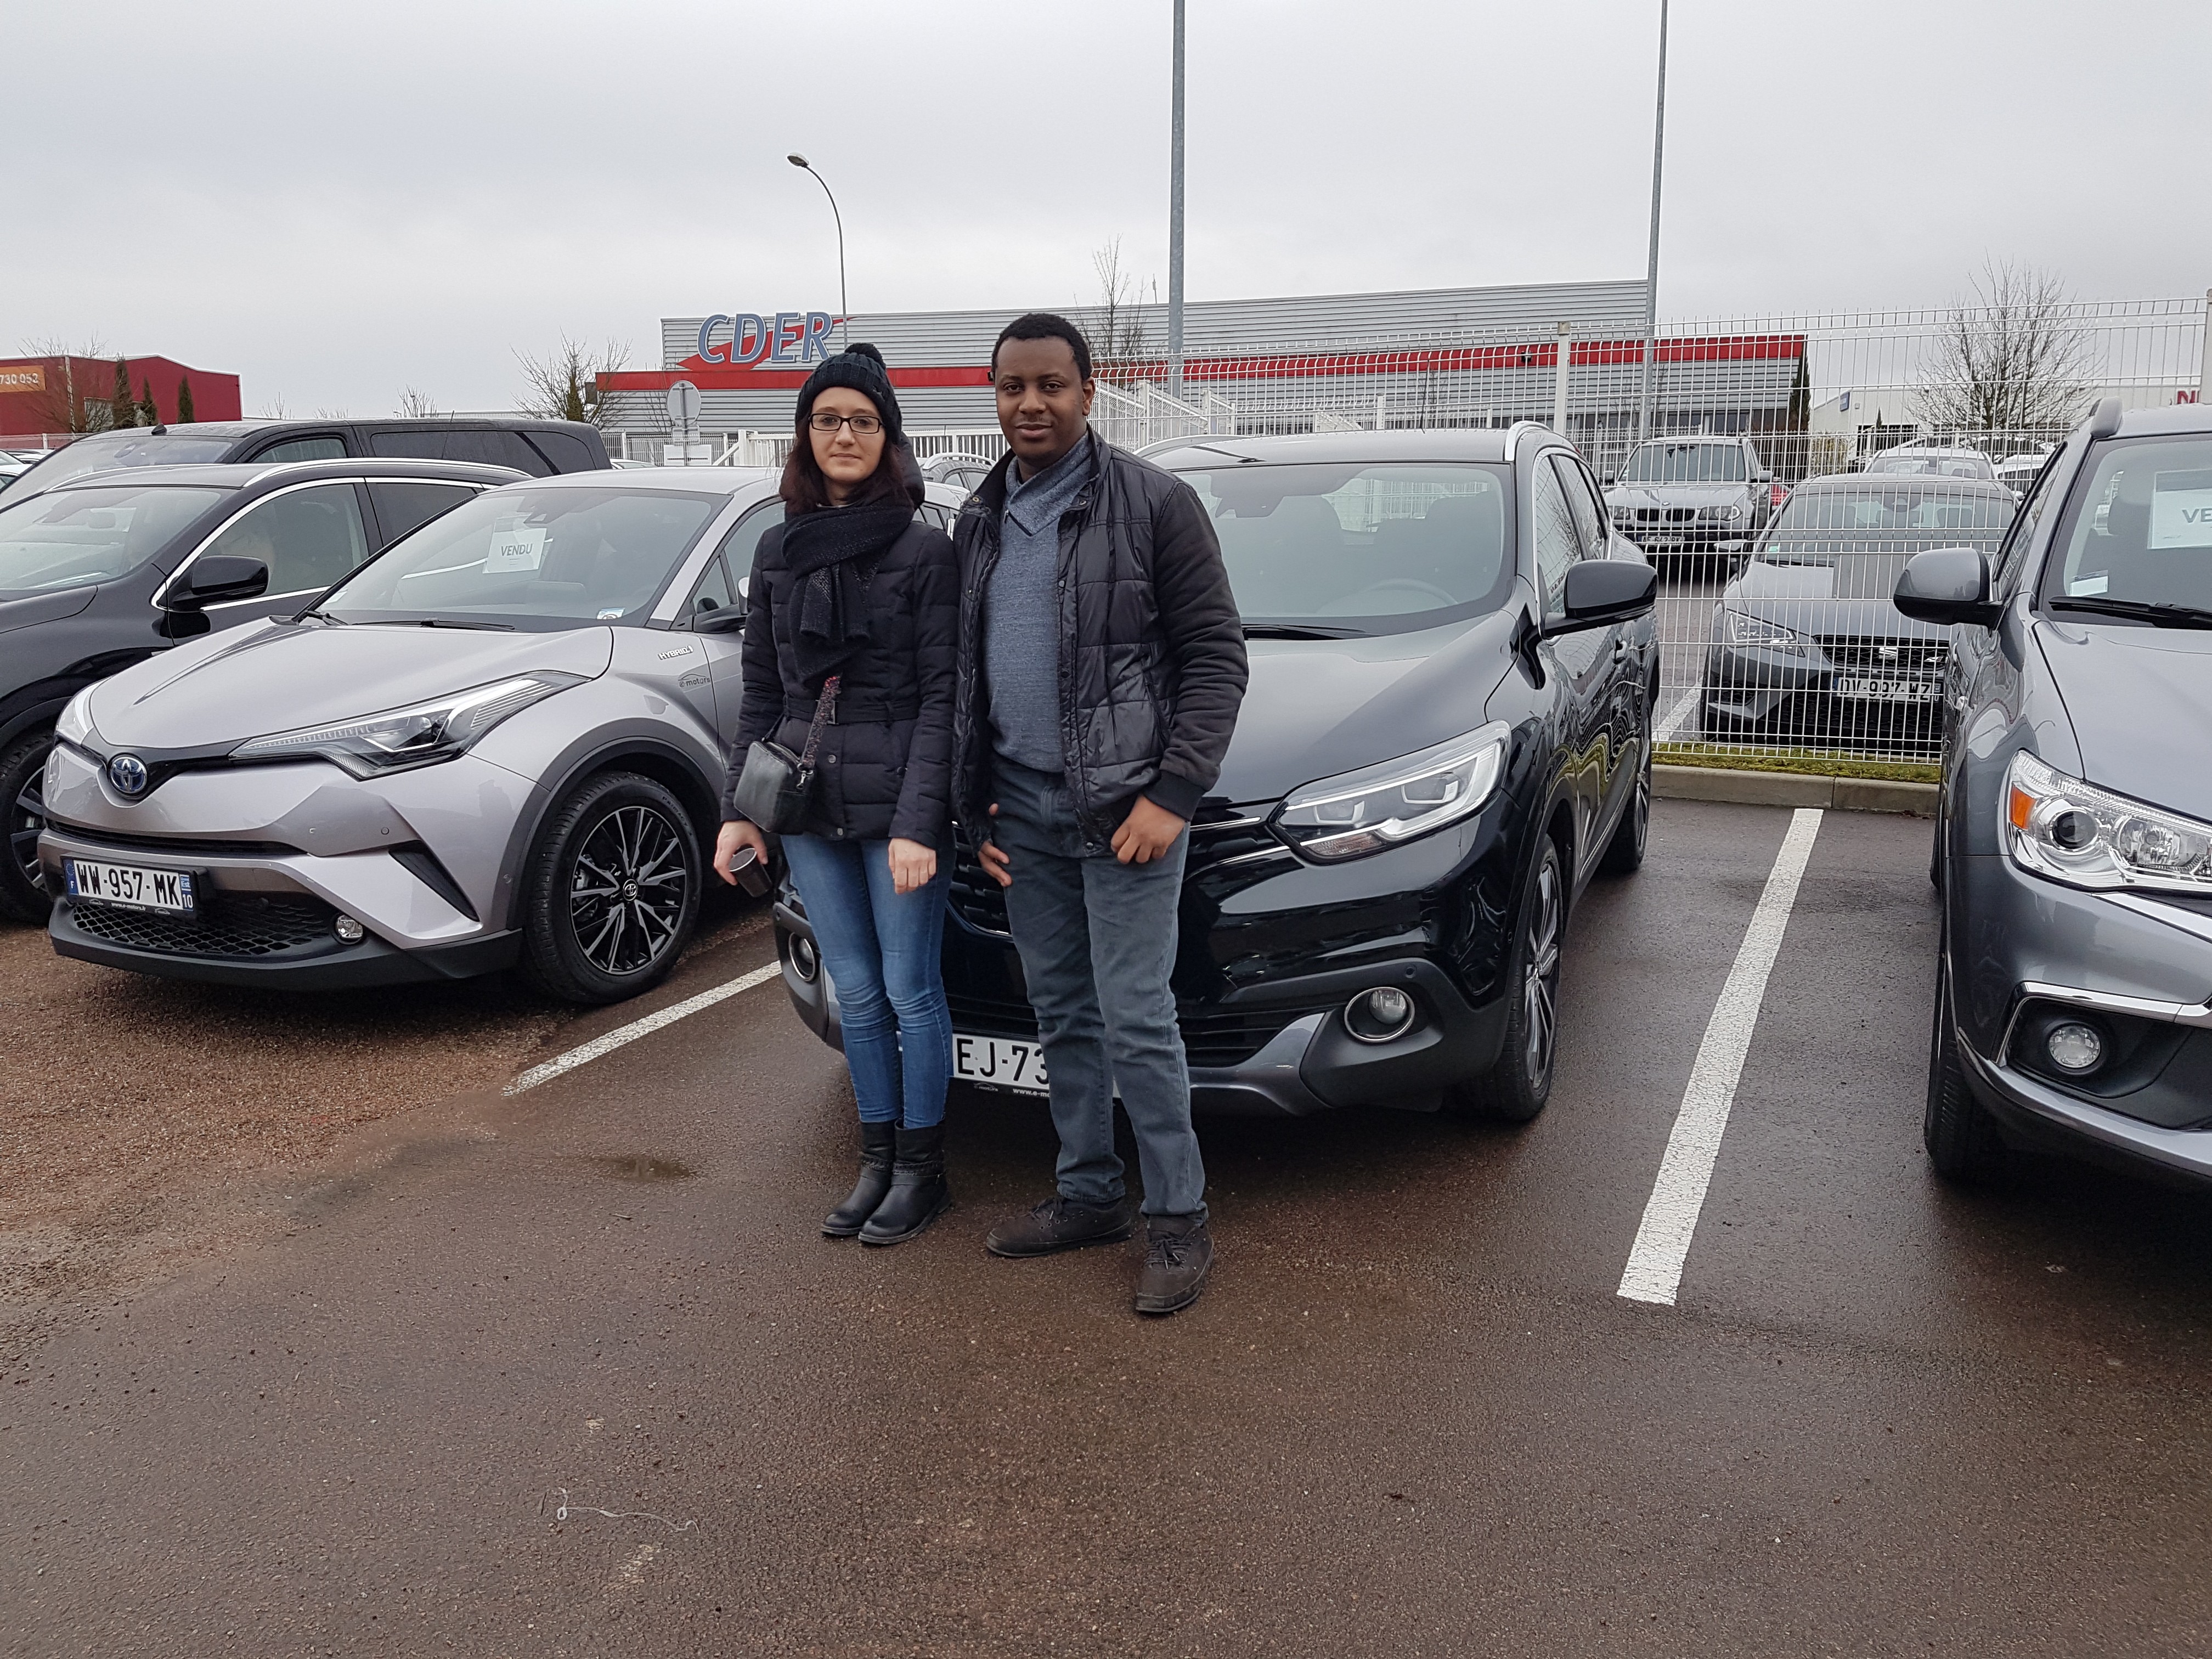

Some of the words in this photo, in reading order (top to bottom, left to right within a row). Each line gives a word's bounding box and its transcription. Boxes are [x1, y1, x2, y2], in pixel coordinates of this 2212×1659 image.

[697, 312, 833, 363] CDER
[2182, 508, 2212, 523] VE
[500, 543, 533, 556] VENDU
[658, 647, 691, 660] HYBRID
[70, 881, 75, 889] F
[76, 864, 180, 906] WW-957-MK
[183, 894, 193, 908] 10
[957, 1038, 1049, 1085] EJ-73
